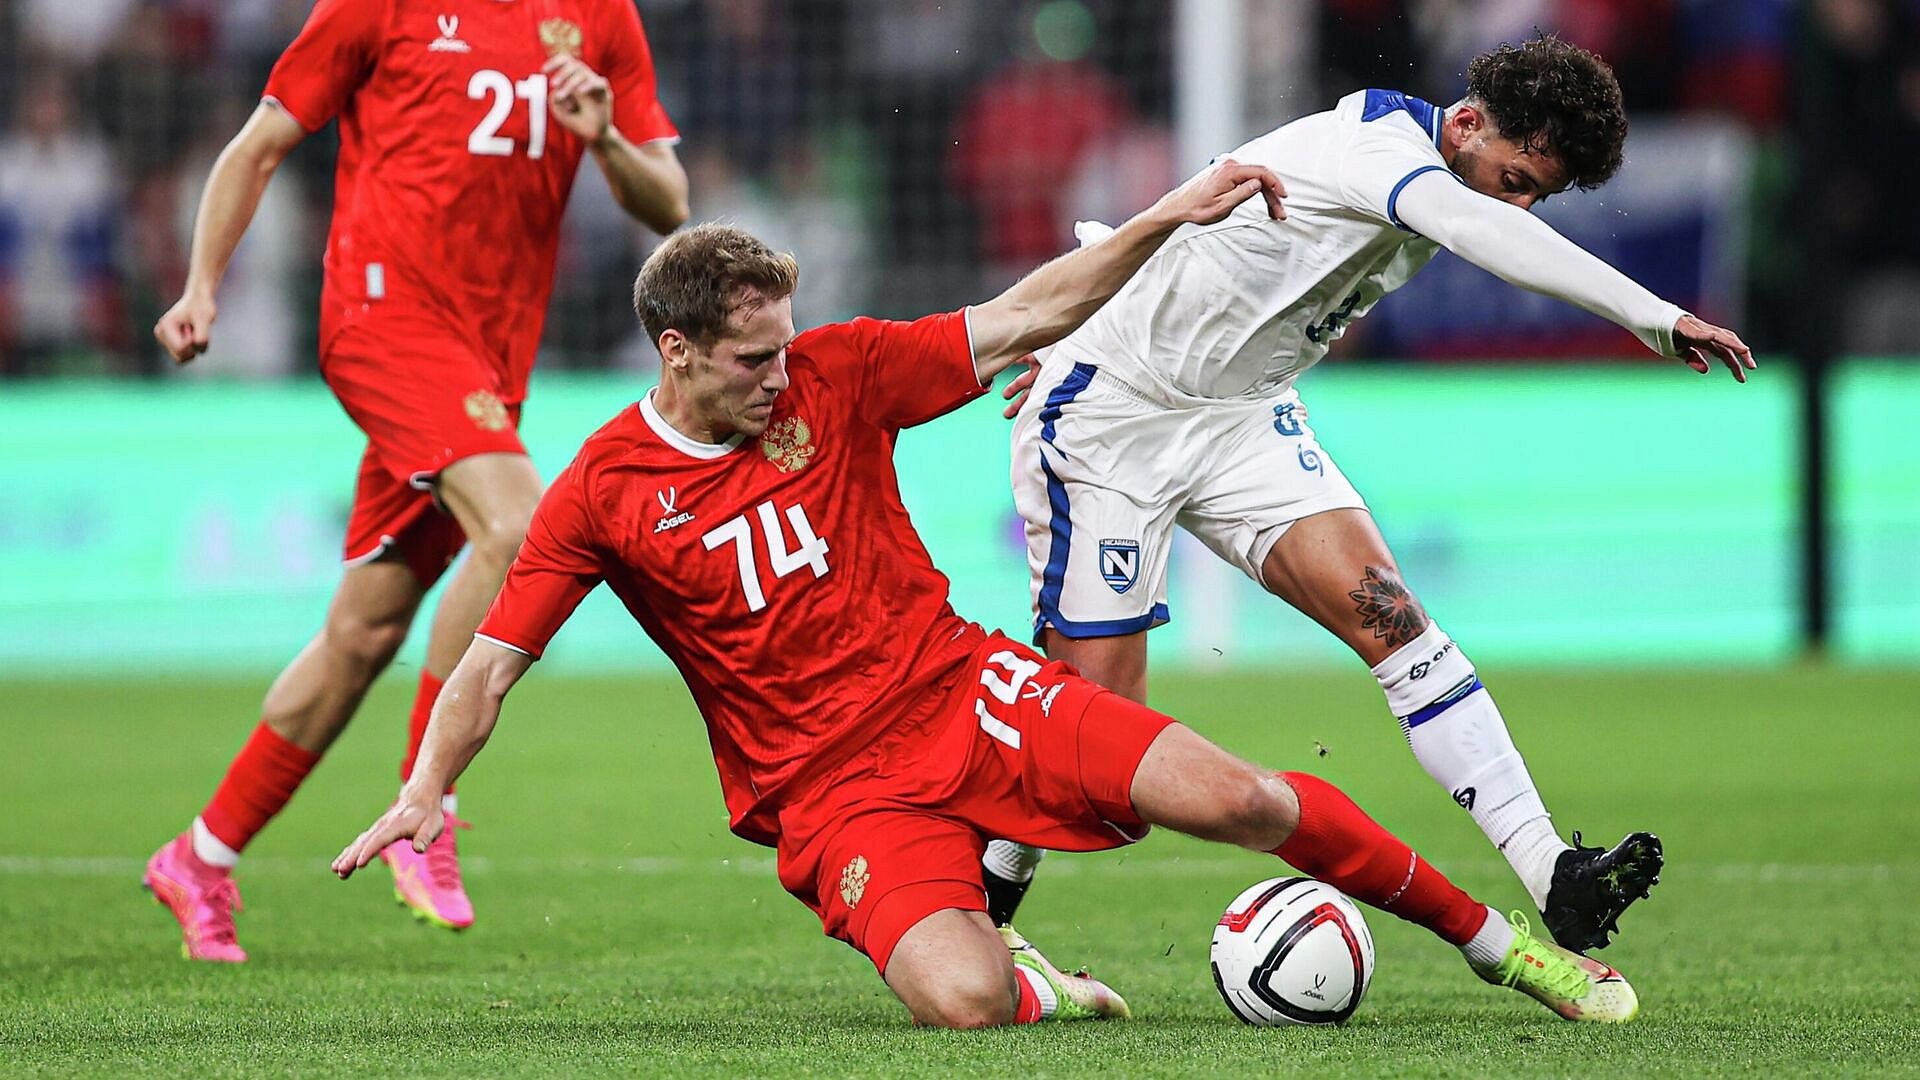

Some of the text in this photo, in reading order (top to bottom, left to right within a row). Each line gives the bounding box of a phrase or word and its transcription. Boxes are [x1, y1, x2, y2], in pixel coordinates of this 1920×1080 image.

[467, 68, 548, 160] 21
[701, 499, 831, 613] 74
[1103, 550, 1136, 581] N
